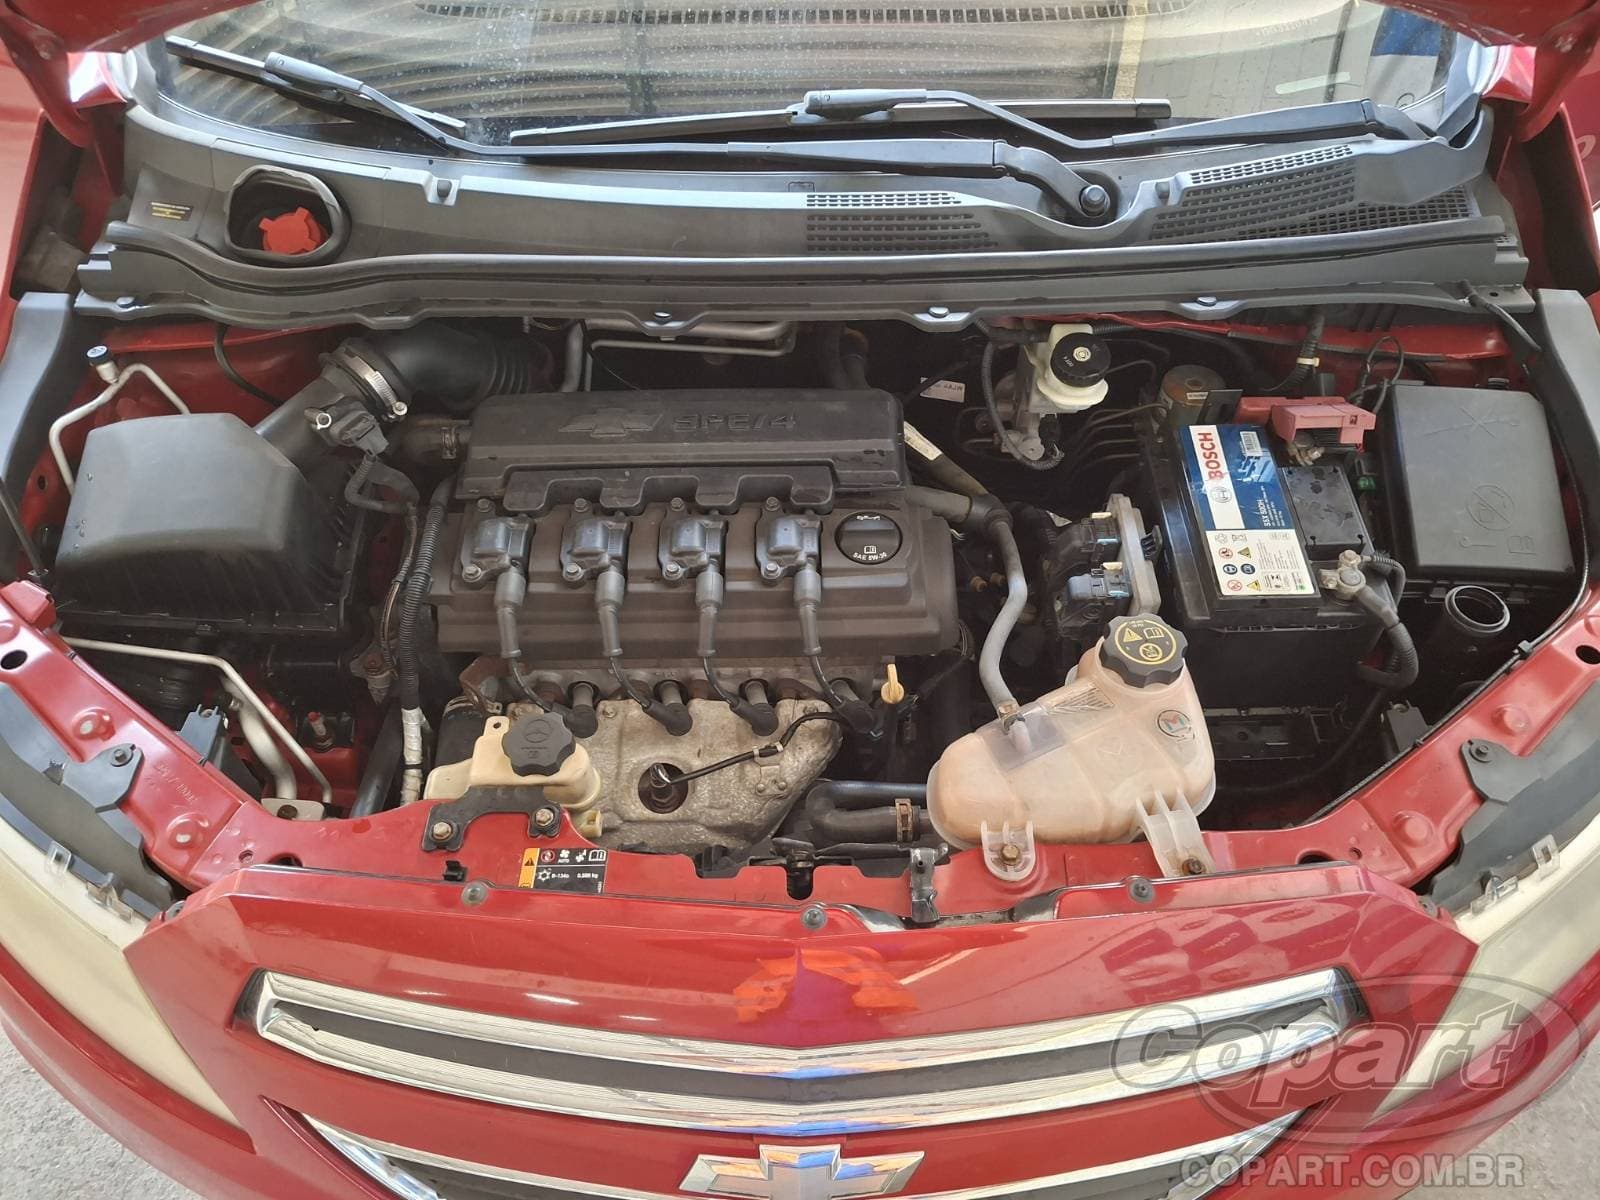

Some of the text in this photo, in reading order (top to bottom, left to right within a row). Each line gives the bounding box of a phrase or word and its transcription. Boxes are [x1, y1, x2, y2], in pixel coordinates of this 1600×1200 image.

[673, 413, 797, 432] SPE/4
[1198, 432, 1224, 480] BOSCH
[853, 552, 867, 560] SAE
